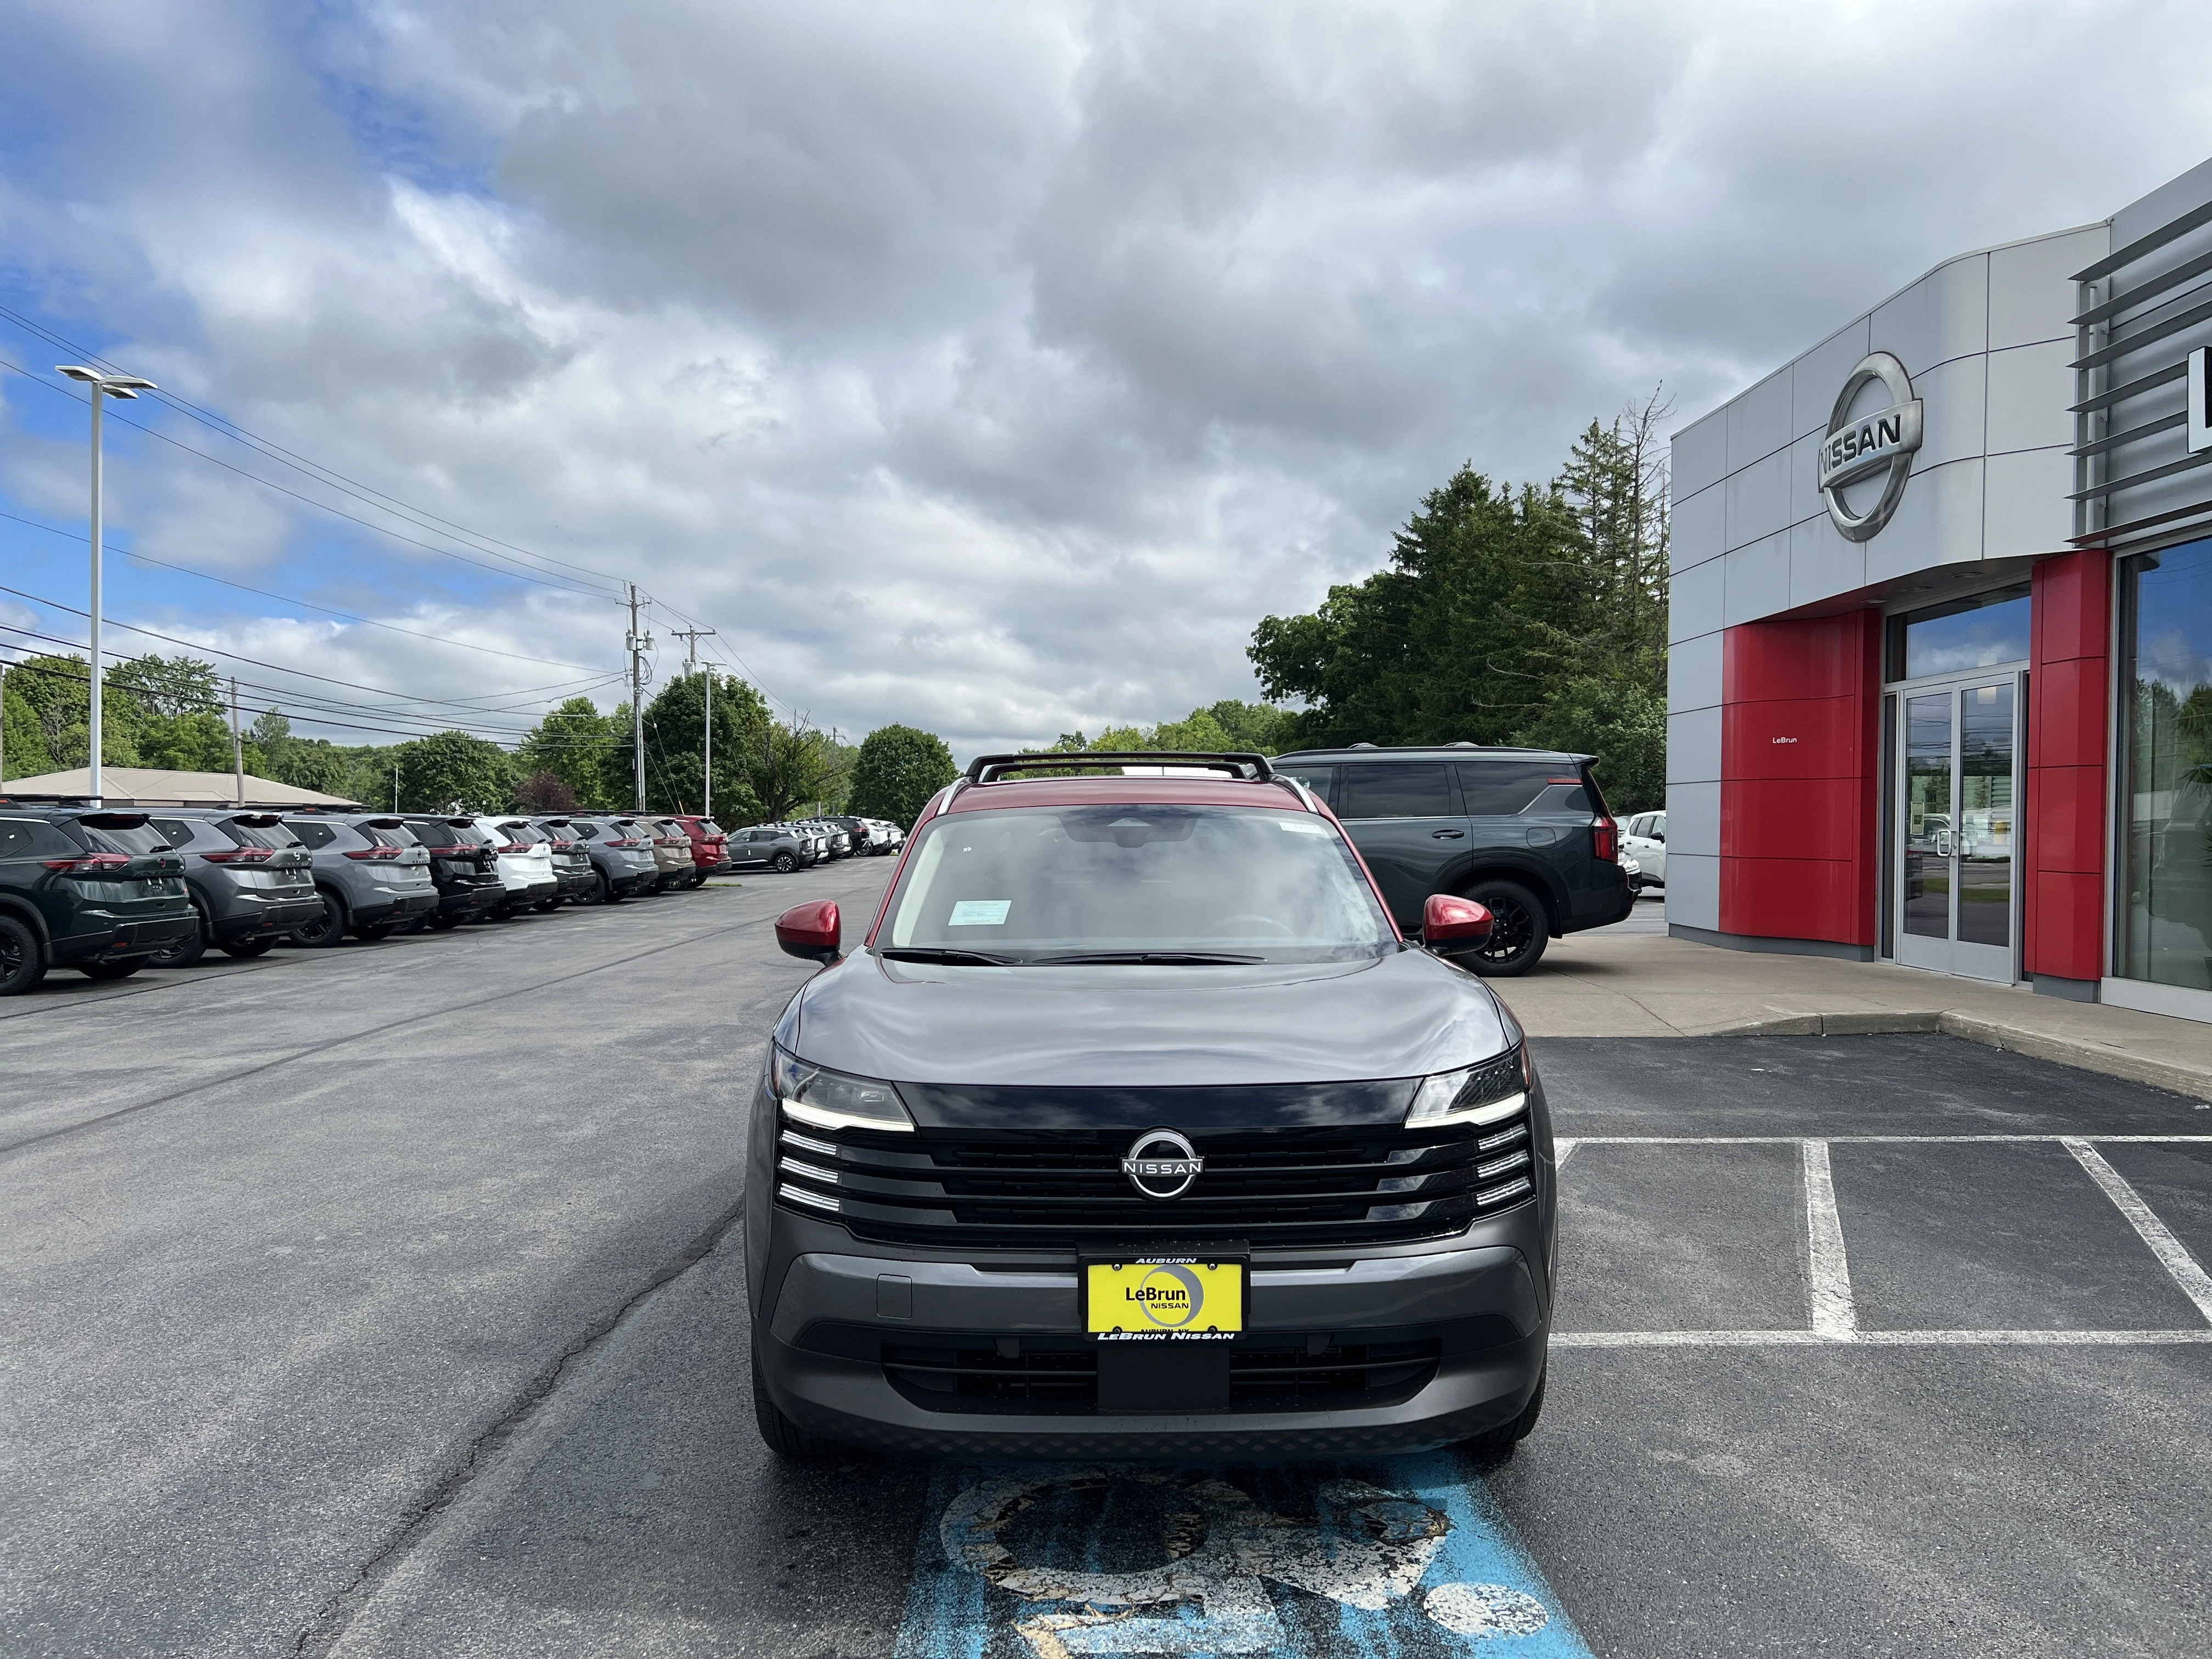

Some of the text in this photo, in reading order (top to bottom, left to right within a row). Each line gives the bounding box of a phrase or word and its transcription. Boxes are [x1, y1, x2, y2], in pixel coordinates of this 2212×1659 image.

[1821, 414, 1900, 474] NISSAN
[1124, 1162, 1201, 1174] NISSAN
[1126, 1287, 1186, 1301] LeBrun
